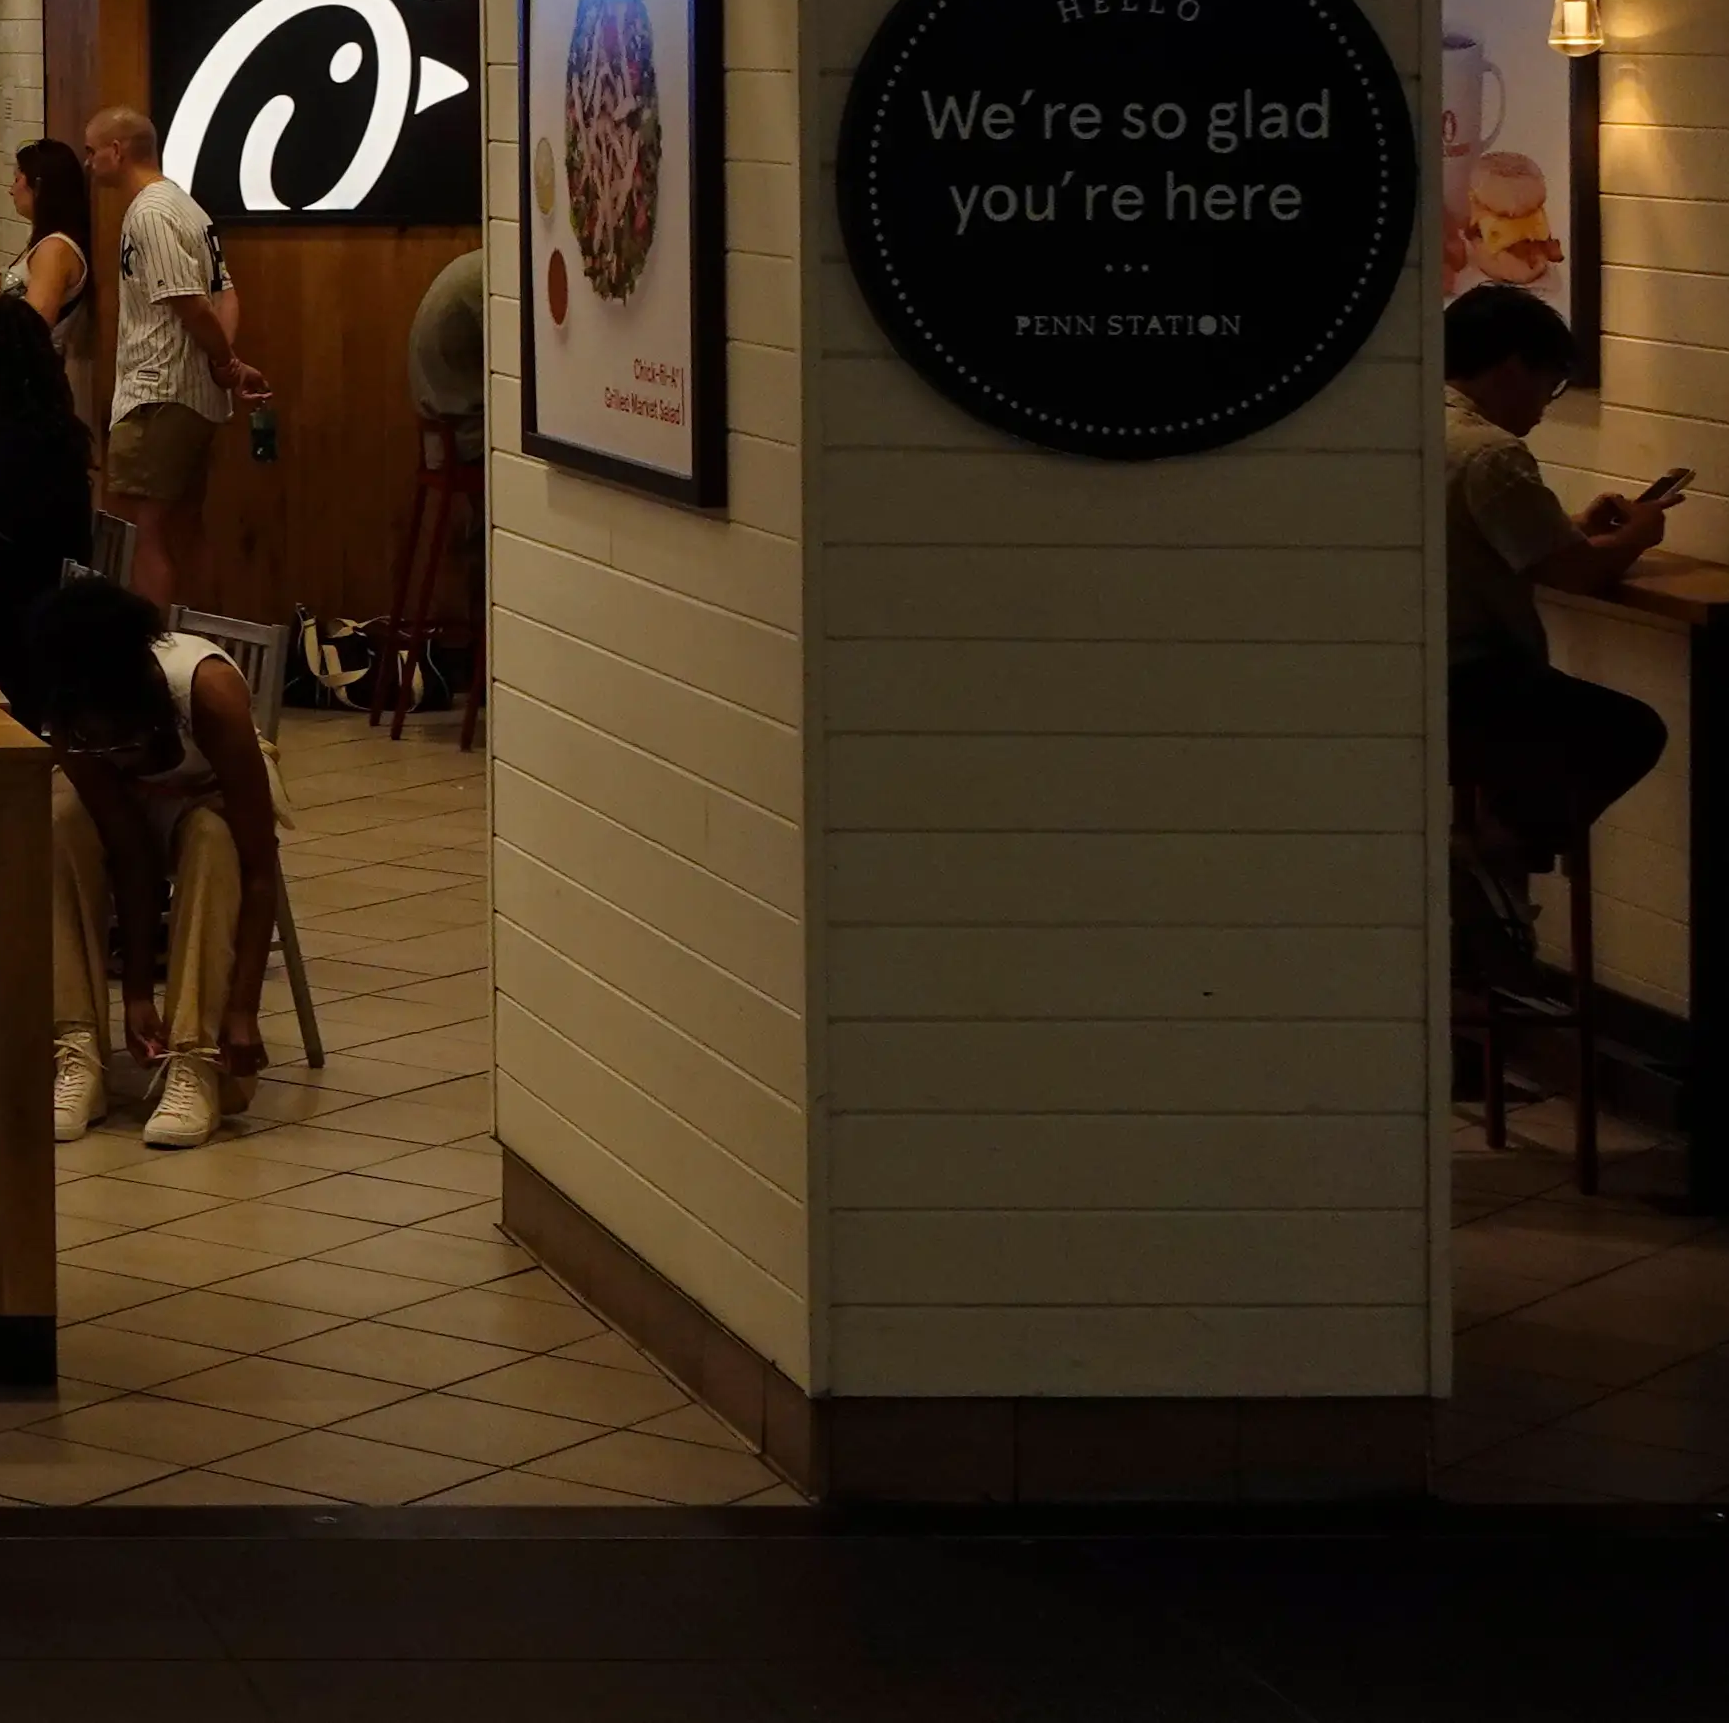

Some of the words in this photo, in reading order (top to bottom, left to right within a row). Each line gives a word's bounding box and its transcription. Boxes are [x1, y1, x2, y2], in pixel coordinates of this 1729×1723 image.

[921, 88, 1104, 141] We're
[1121, 101, 1188, 141] so
[1206, 88, 1332, 154] glad
[949, 171, 1145, 235] you're
[1167, 171, 1304, 222] here
[1015, 314, 1096, 337] PENN
[1107, 314, 1242, 337] STATION
